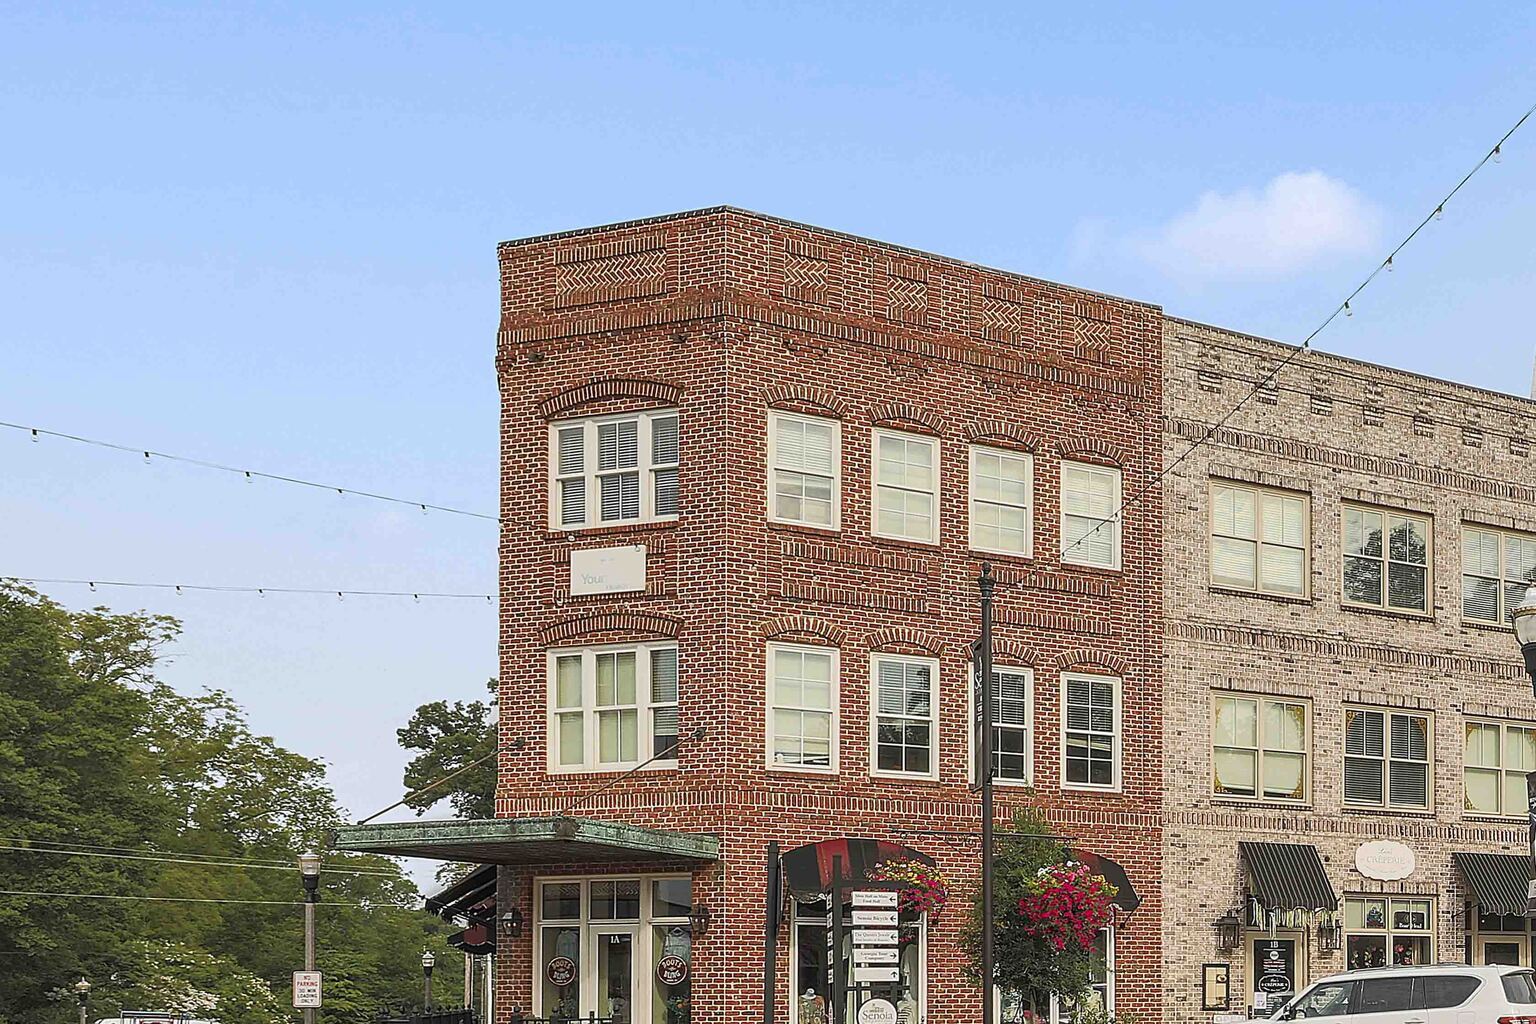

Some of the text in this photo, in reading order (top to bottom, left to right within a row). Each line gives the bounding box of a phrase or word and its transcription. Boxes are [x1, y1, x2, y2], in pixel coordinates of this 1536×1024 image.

[610, 935, 620, 944] 1A
[553, 960, 571, 969] BOOTS
[662, 959, 683, 969] BOOTS
[553, 971, 570, 980] BLING
[663, 970, 681, 980] BLING
[862, 1010, 893, 1020] Senoia
